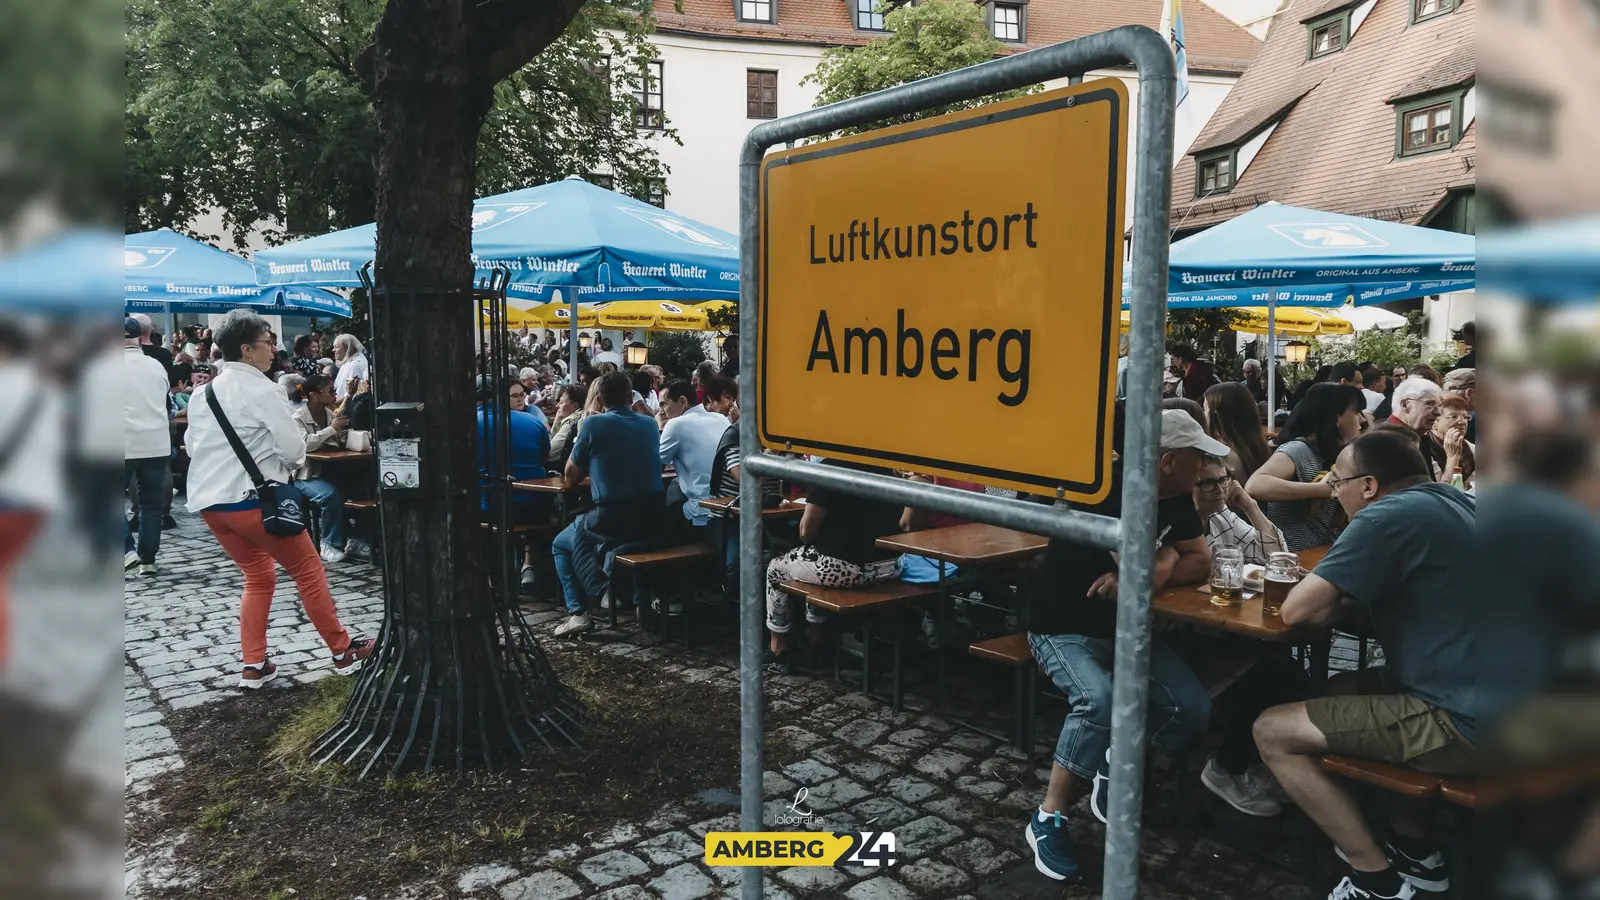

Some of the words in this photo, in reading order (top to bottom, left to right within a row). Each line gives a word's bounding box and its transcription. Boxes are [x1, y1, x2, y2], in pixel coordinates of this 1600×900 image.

[810, 202, 1038, 265] Luftkunstort
[269, 259, 309, 275] Brauerei
[310, 258, 351, 272] Winkler
[470, 252, 523, 271] Brauerei
[526, 256, 581, 273] Winkler
[622, 260, 666, 277] Brauerei
[669, 263, 708, 279] Winkler
[1181, 270, 1237, 285] Brauerei
[1241, 268, 1297, 280] Winkler
[1315, 268, 1360, 278] ORIGINAL
[1361, 268, 1381, 276] AUS
[1381, 266, 1421, 275] AMBERG
[165, 282, 213, 295] Brauerei
[217, 284, 262, 297] Winkler
[806, 308, 1032, 407] Amberg
